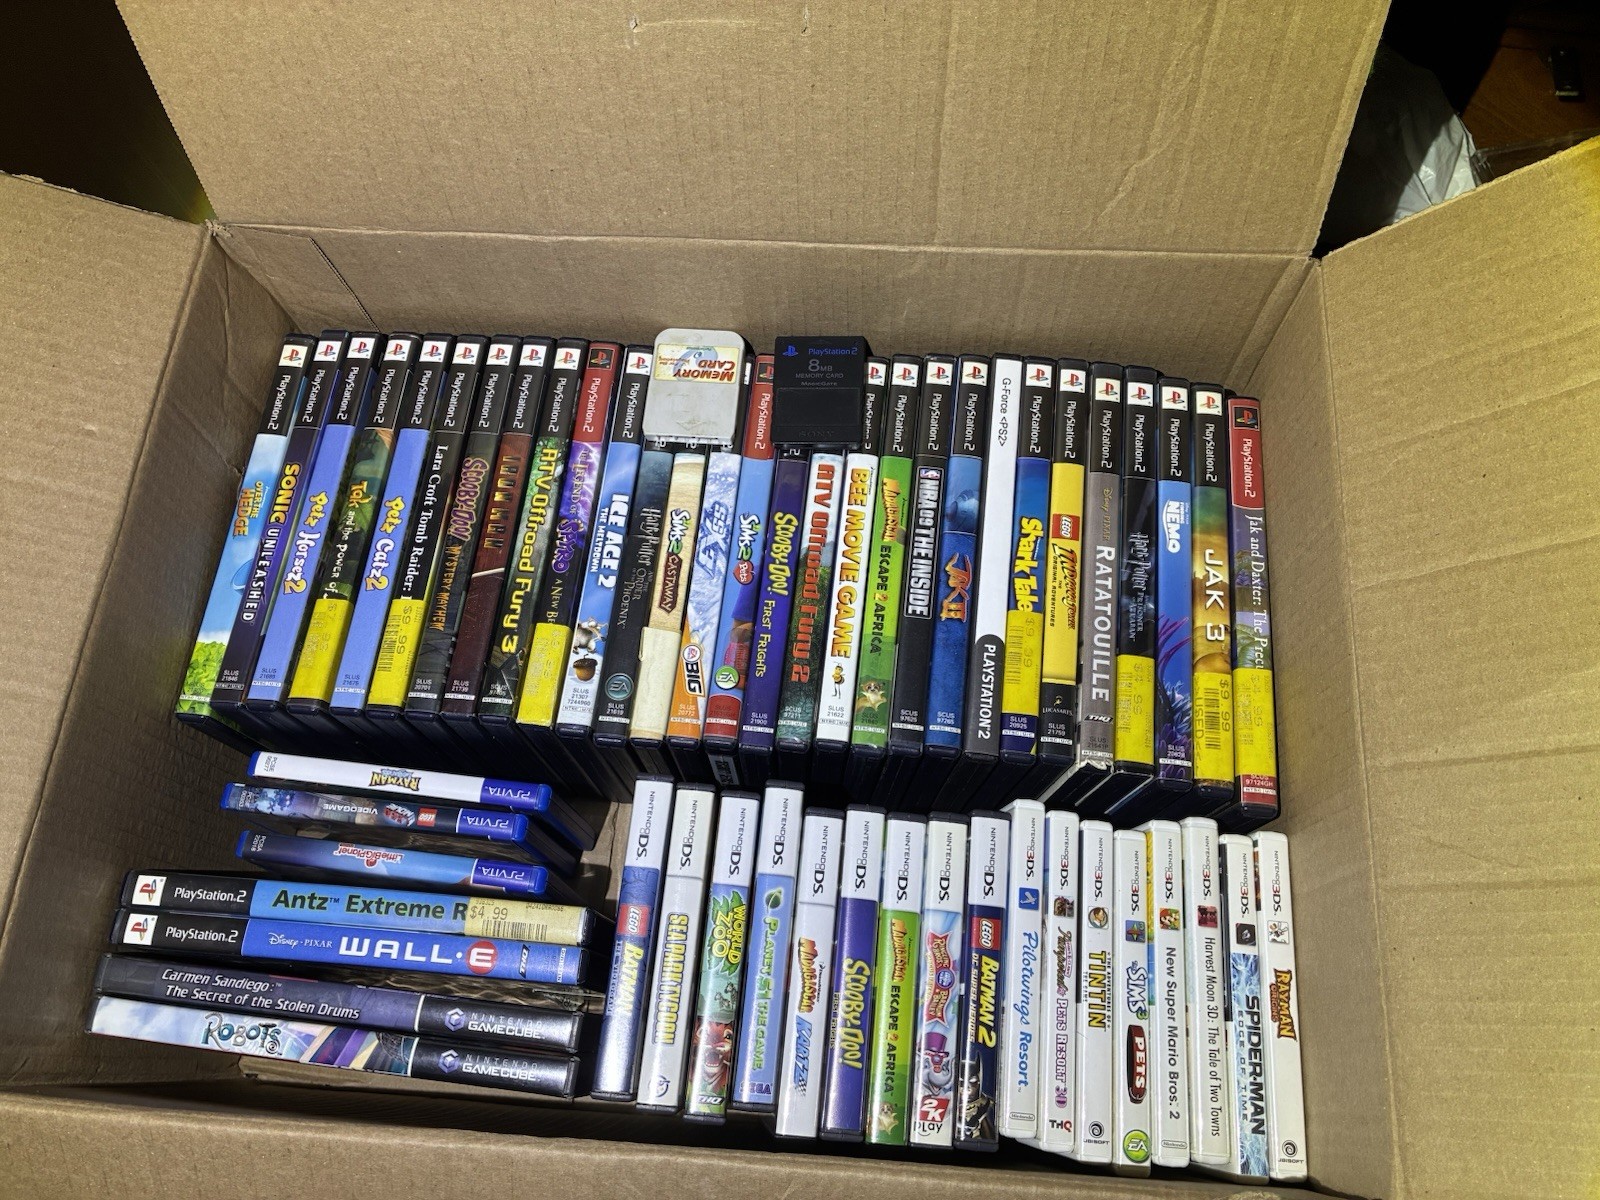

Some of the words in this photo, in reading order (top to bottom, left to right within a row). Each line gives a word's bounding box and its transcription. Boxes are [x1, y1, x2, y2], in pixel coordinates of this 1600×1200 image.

[673, 369, 734, 382] MEMORY
[698, 359, 735, 371] CARD
[1002, 378, 1012, 414] G-Force
[998, 416, 1008, 447] <PS2>
[433, 445, 449, 471] Lara
[537, 449, 558, 493] ATV
[269, 463, 300, 524] SONIC
[349, 480, 373, 508] Tak
[424, 474, 442, 506] Croft
[494, 455, 521, 502] IRON
[571, 463, 589, 502] LEGEND
[813, 463, 836, 509] ATV
[847, 468, 869, 507] BEE
[234, 489, 251, 536] HEDGE
[303, 491, 329, 527] Petz
[379, 496, 406, 534] Petz
[415, 510, 434, 544] Tomb
[612, 494, 629, 528] ICE
[1167, 500, 1181, 553] NEMO
[1245, 514, 1263, 534] Jak
[484, 507, 510, 549] MAN
[518, 494, 548, 572] Offroad
[840, 508, 866, 583] MOVIE
[590, 528, 606, 573] MELTDOWN
[603, 531, 624, 570] AGE
[1012, 516, 1044, 579] Shark
[1250, 537, 1260, 557] and
[242, 528, 280, 621] UNLEASHED
[403, 546, 425, 591] Raider:
[444, 545, 462, 590] MYSTERY
[598, 574, 617, 588] 2
[660, 555, 679, 611] CASTAWAY
[876, 544, 892, 591] ESCAPE
[1204, 549, 1225, 610] JAK
[1251, 560, 1265, 606] Daxter:
[429, 592, 450, 631] MAYHEM
[502, 578, 532, 629] Fury
[616, 581, 633, 626] PHOENIX
[763, 600, 776, 630] FIRST
[831, 585, 858, 658] GAME
[1253, 609, 1267, 634] The
[793, 605, 817, 660] Fury
[869, 602, 886, 654] AFRICA
[1092, 545, 1116, 702] RATATOUILLE
[1205, 622, 1226, 641] 3
[501, 634, 519, 653] 3
[755, 633, 772, 677] FRIGHTS
[686, 662, 702, 695] BIG
[791, 662, 810, 684] 2
[370, 772, 421, 792] RAYMAN
[322, 803, 378, 815] VIDEOGAME
[272, 889, 328, 910] Antz
[345, 894, 445, 919] Extreme
[627, 906, 640, 934] LEGO
[668, 913, 689, 942] SEA
[712, 912, 733, 958] ZOO
[728, 904, 747, 965] WORLD
[759, 917, 779, 975] PLANET
[980, 919, 992, 949] LEGO
[662, 942, 686, 986] PARK
[1165, 946, 1177, 976] New
[1205, 937, 1216, 972] Harvest
[162, 968, 210, 985] Carmen
[977, 954, 1000, 1027] BATMAN
[1012, 930, 1039, 1026] Pilotwings
[1087, 950, 1107, 1030] TINTIN
[1205, 973, 1215, 1002] Moon
[165, 985, 189, 998] The
[191, 987, 231, 1004] Secret
[234, 994, 250, 1006] of
[251, 996, 273, 1008] the
[275, 999, 315, 1014] Stolen
[317, 1003, 360, 1019] Drums
[470, 1012, 543, 1029] NINTENDO
[655, 984, 683, 1045] TYCOON
[755, 1001, 769, 1026] THE
[887, 985, 900, 1030] ESCAPE
[1055, 998, 1069, 1032] PETS
[1164, 981, 1177, 1028] Super
[1274, 968, 1298, 1042] RAYMAN
[468, 1021, 542, 1039] GAMECUBE
[750, 1027, 768, 1070] GAME
[977, 1026, 997, 1048] 2
[1165, 1027, 1179, 1067] Mario
[1208, 1026, 1219, 1045] The
[462, 1063, 536, 1081] GAMECUBE
[465, 1054, 538, 1069] NINTENDO
[884, 1043, 897, 1094] AFRICA
[1018, 1031, 1033, 1087] Resort
[1055, 1034, 1068, 1082] RESORT
[1134, 1036, 1147, 1089] PETS
[1208, 1047, 1221, 1067] Tale
[1209, 1068, 1218, 1080] of
[1239, 1057, 1246, 1078] OF
[1167, 1071, 1180, 1107] Bros.
[1210, 1083, 1221, 1106] Two
[919, 1098, 944, 1122] 2K
[1049, 1119, 1072, 1133] THQ
[1169, 1111, 1180, 1120] 2
[1210, 1106, 1221, 1137] Towns
